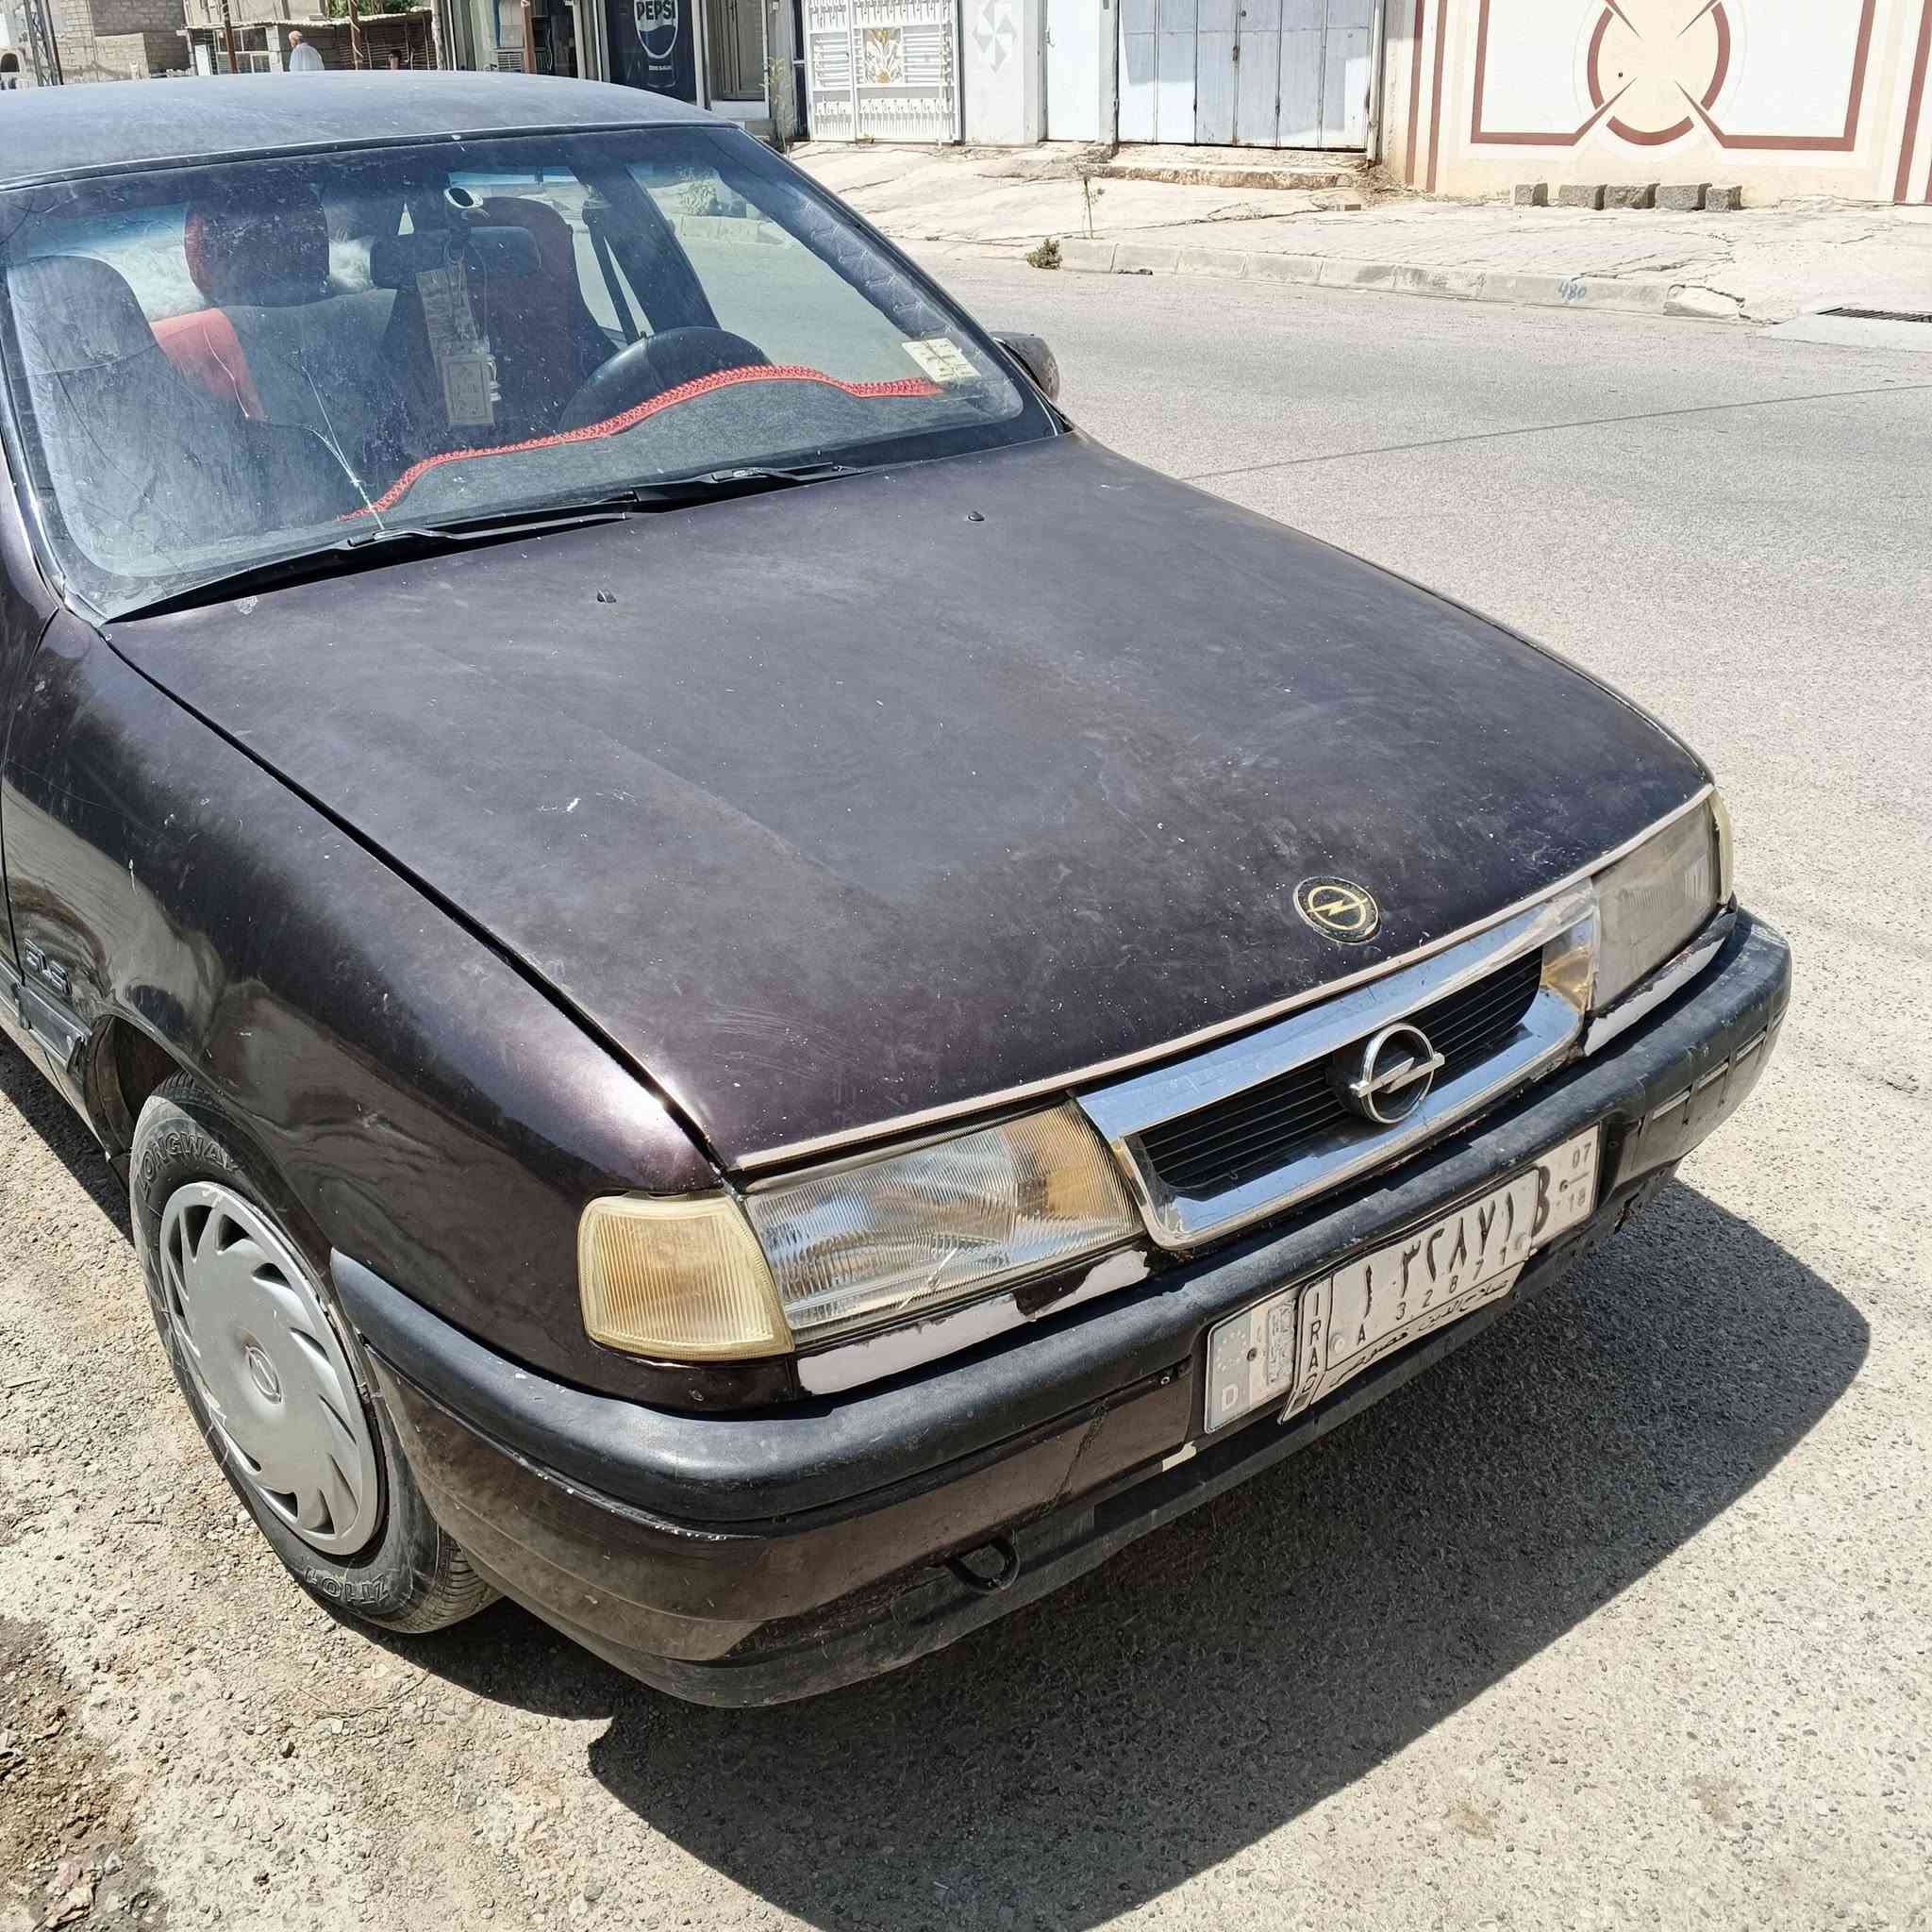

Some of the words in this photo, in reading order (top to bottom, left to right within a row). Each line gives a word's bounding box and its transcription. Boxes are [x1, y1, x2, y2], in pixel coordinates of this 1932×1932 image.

[636, 0, 676, 21] PEPSI
[1572, 1141, 1592, 1169] 07
[1357, 1324, 1366, 1346] A
[1395, 1245, 1507, 1321] 32871
[1222, 1383, 1240, 1412] D
